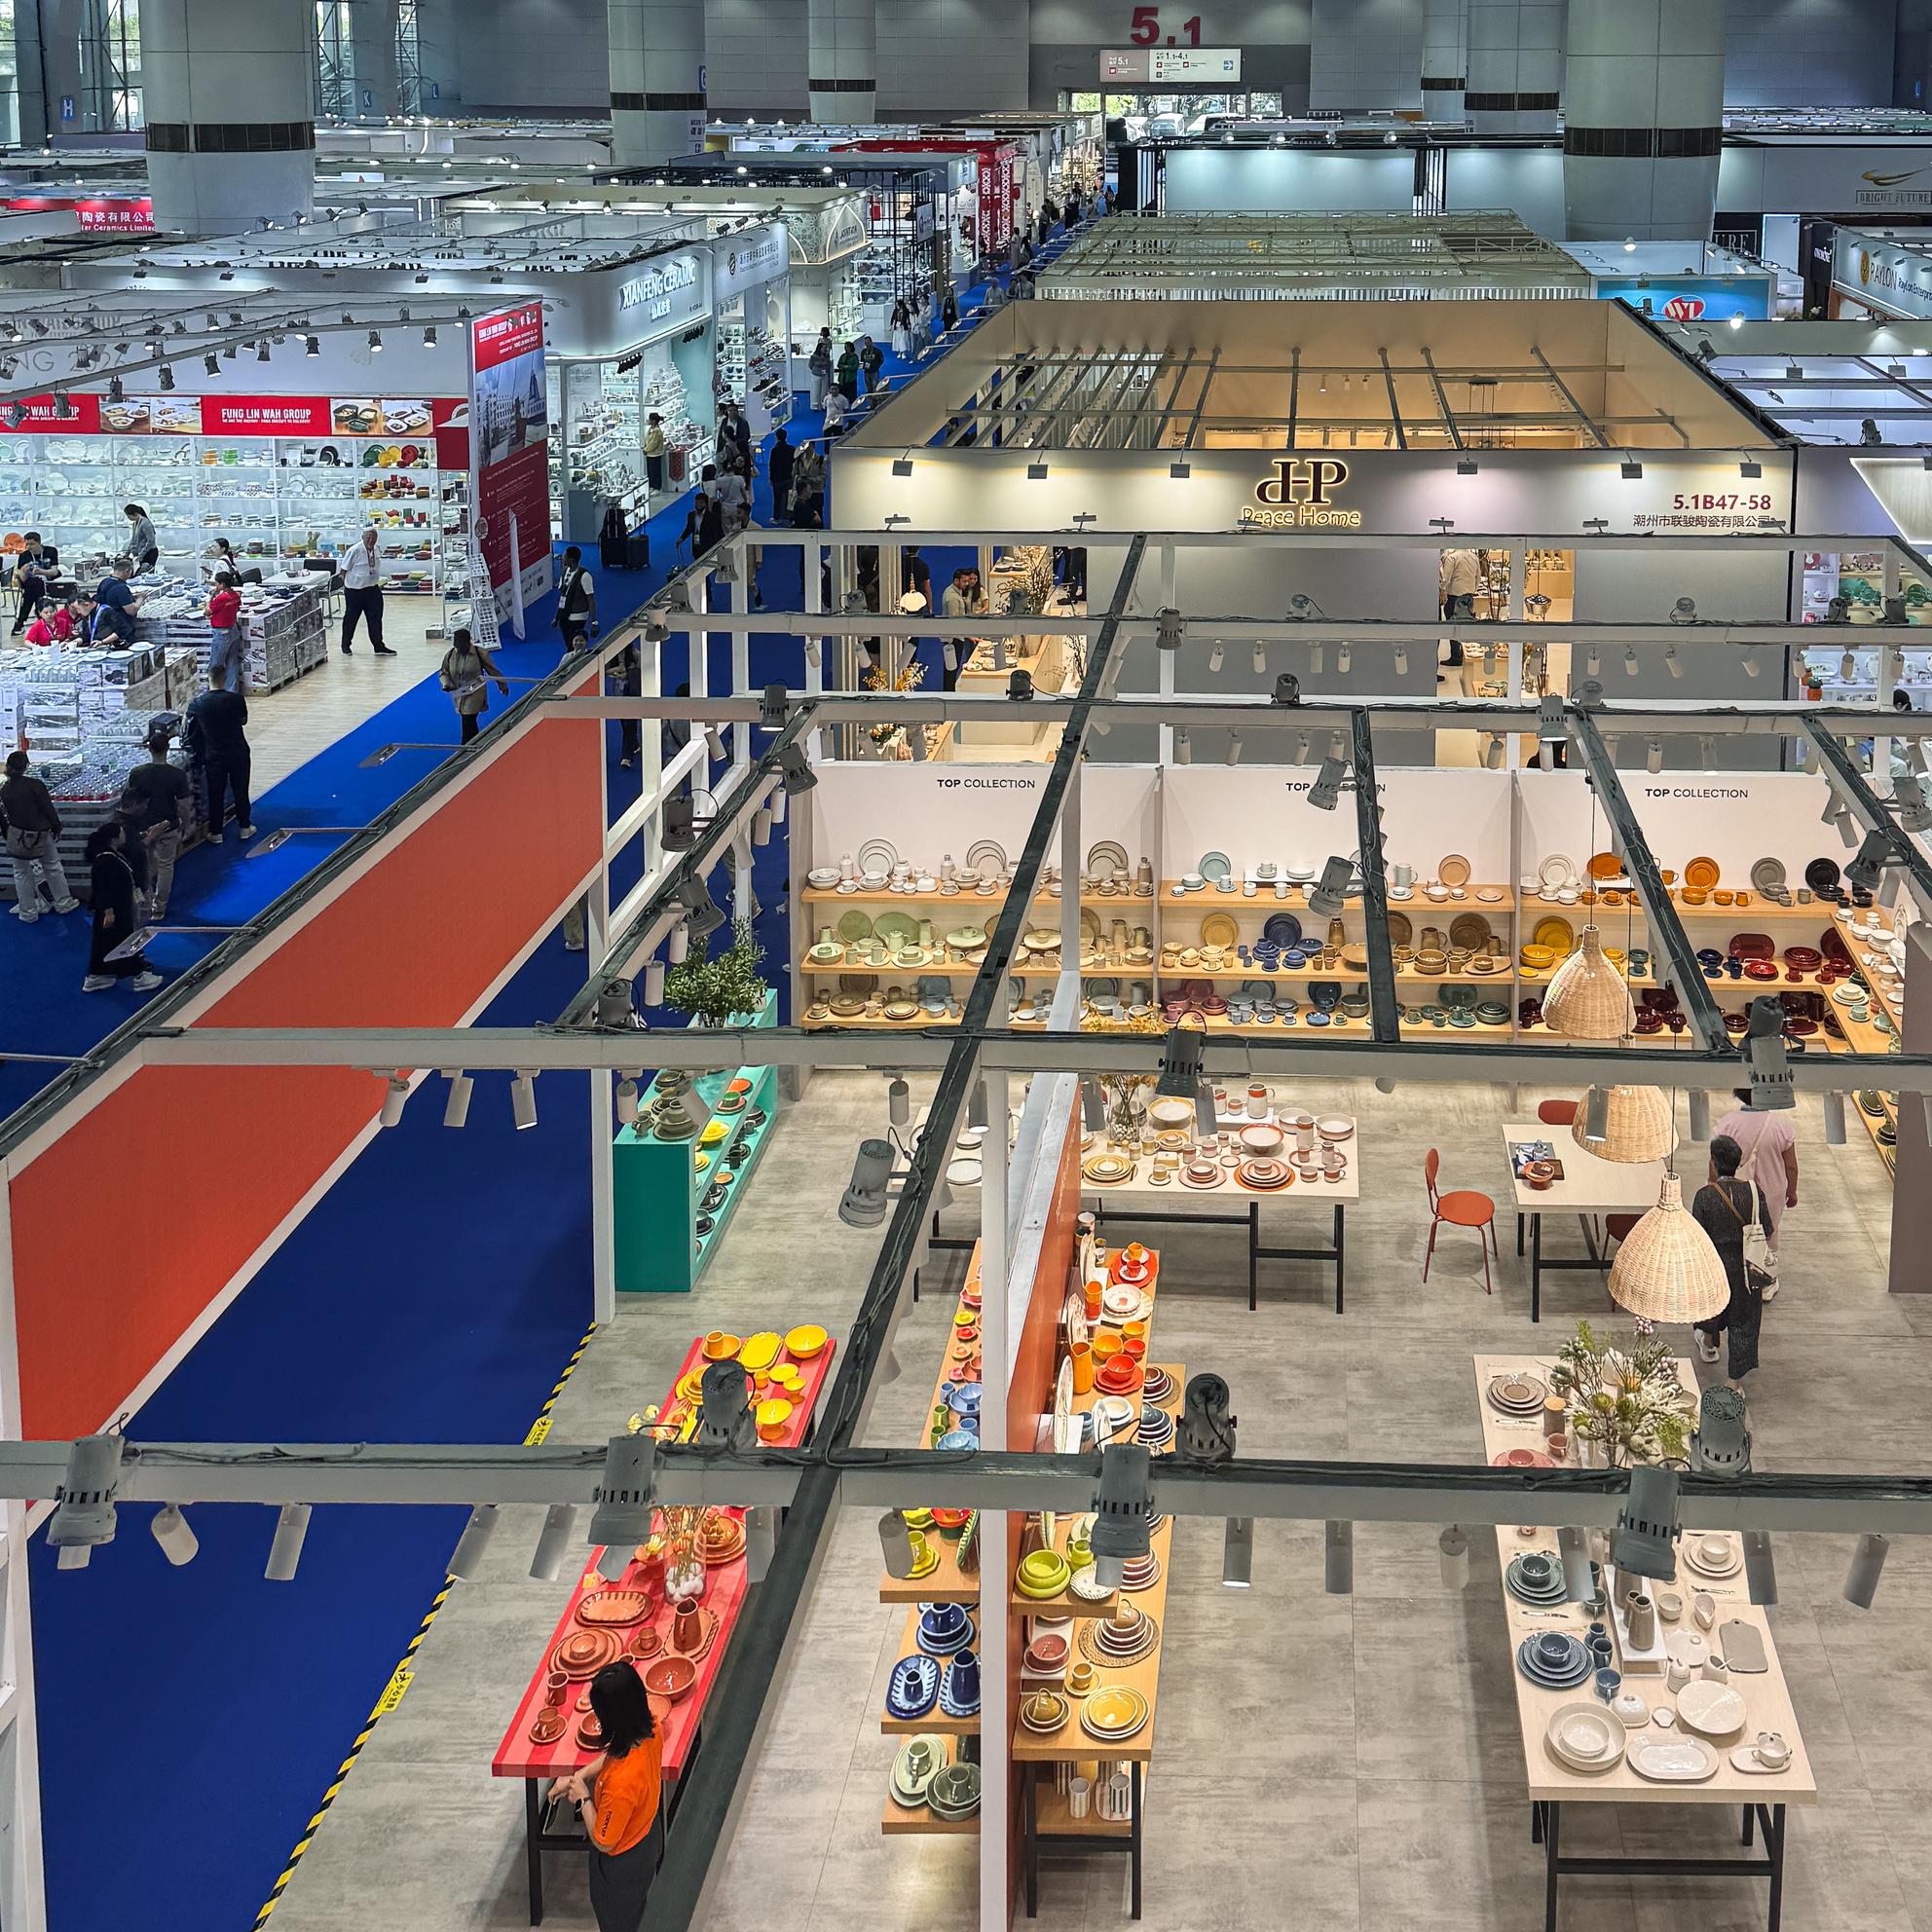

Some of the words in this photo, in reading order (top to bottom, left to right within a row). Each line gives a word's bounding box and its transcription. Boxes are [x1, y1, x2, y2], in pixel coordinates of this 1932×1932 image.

[1130, 7, 1201, 47] 5.1
[63, 99, 74, 118] H
[1860, 192, 1892, 204] BRIGHT
[1894, 192, 1930, 204] FUTURE
[1870, 262, 1898, 291] RAYLON
[623, 274, 663, 309] XIANFENG
[663, 263, 696, 292] CERAMIC
[222, 409, 243, 419] FUNG
[245, 409, 260, 419] LIN
[262, 409, 281, 419] WAH
[282, 409, 312, 419] GROUP
[1673, 494, 1771, 510] 5.1B47-58
[1300, 505, 1361, 526] Home
[937, 779, 961, 788] TOP
[964, 779, 1035, 789] COLLECTION
[1285, 783, 1311, 792] TOP
[1645, 788, 1670, 798] TOP
[1673, 788, 1749, 799] COLLECTION
